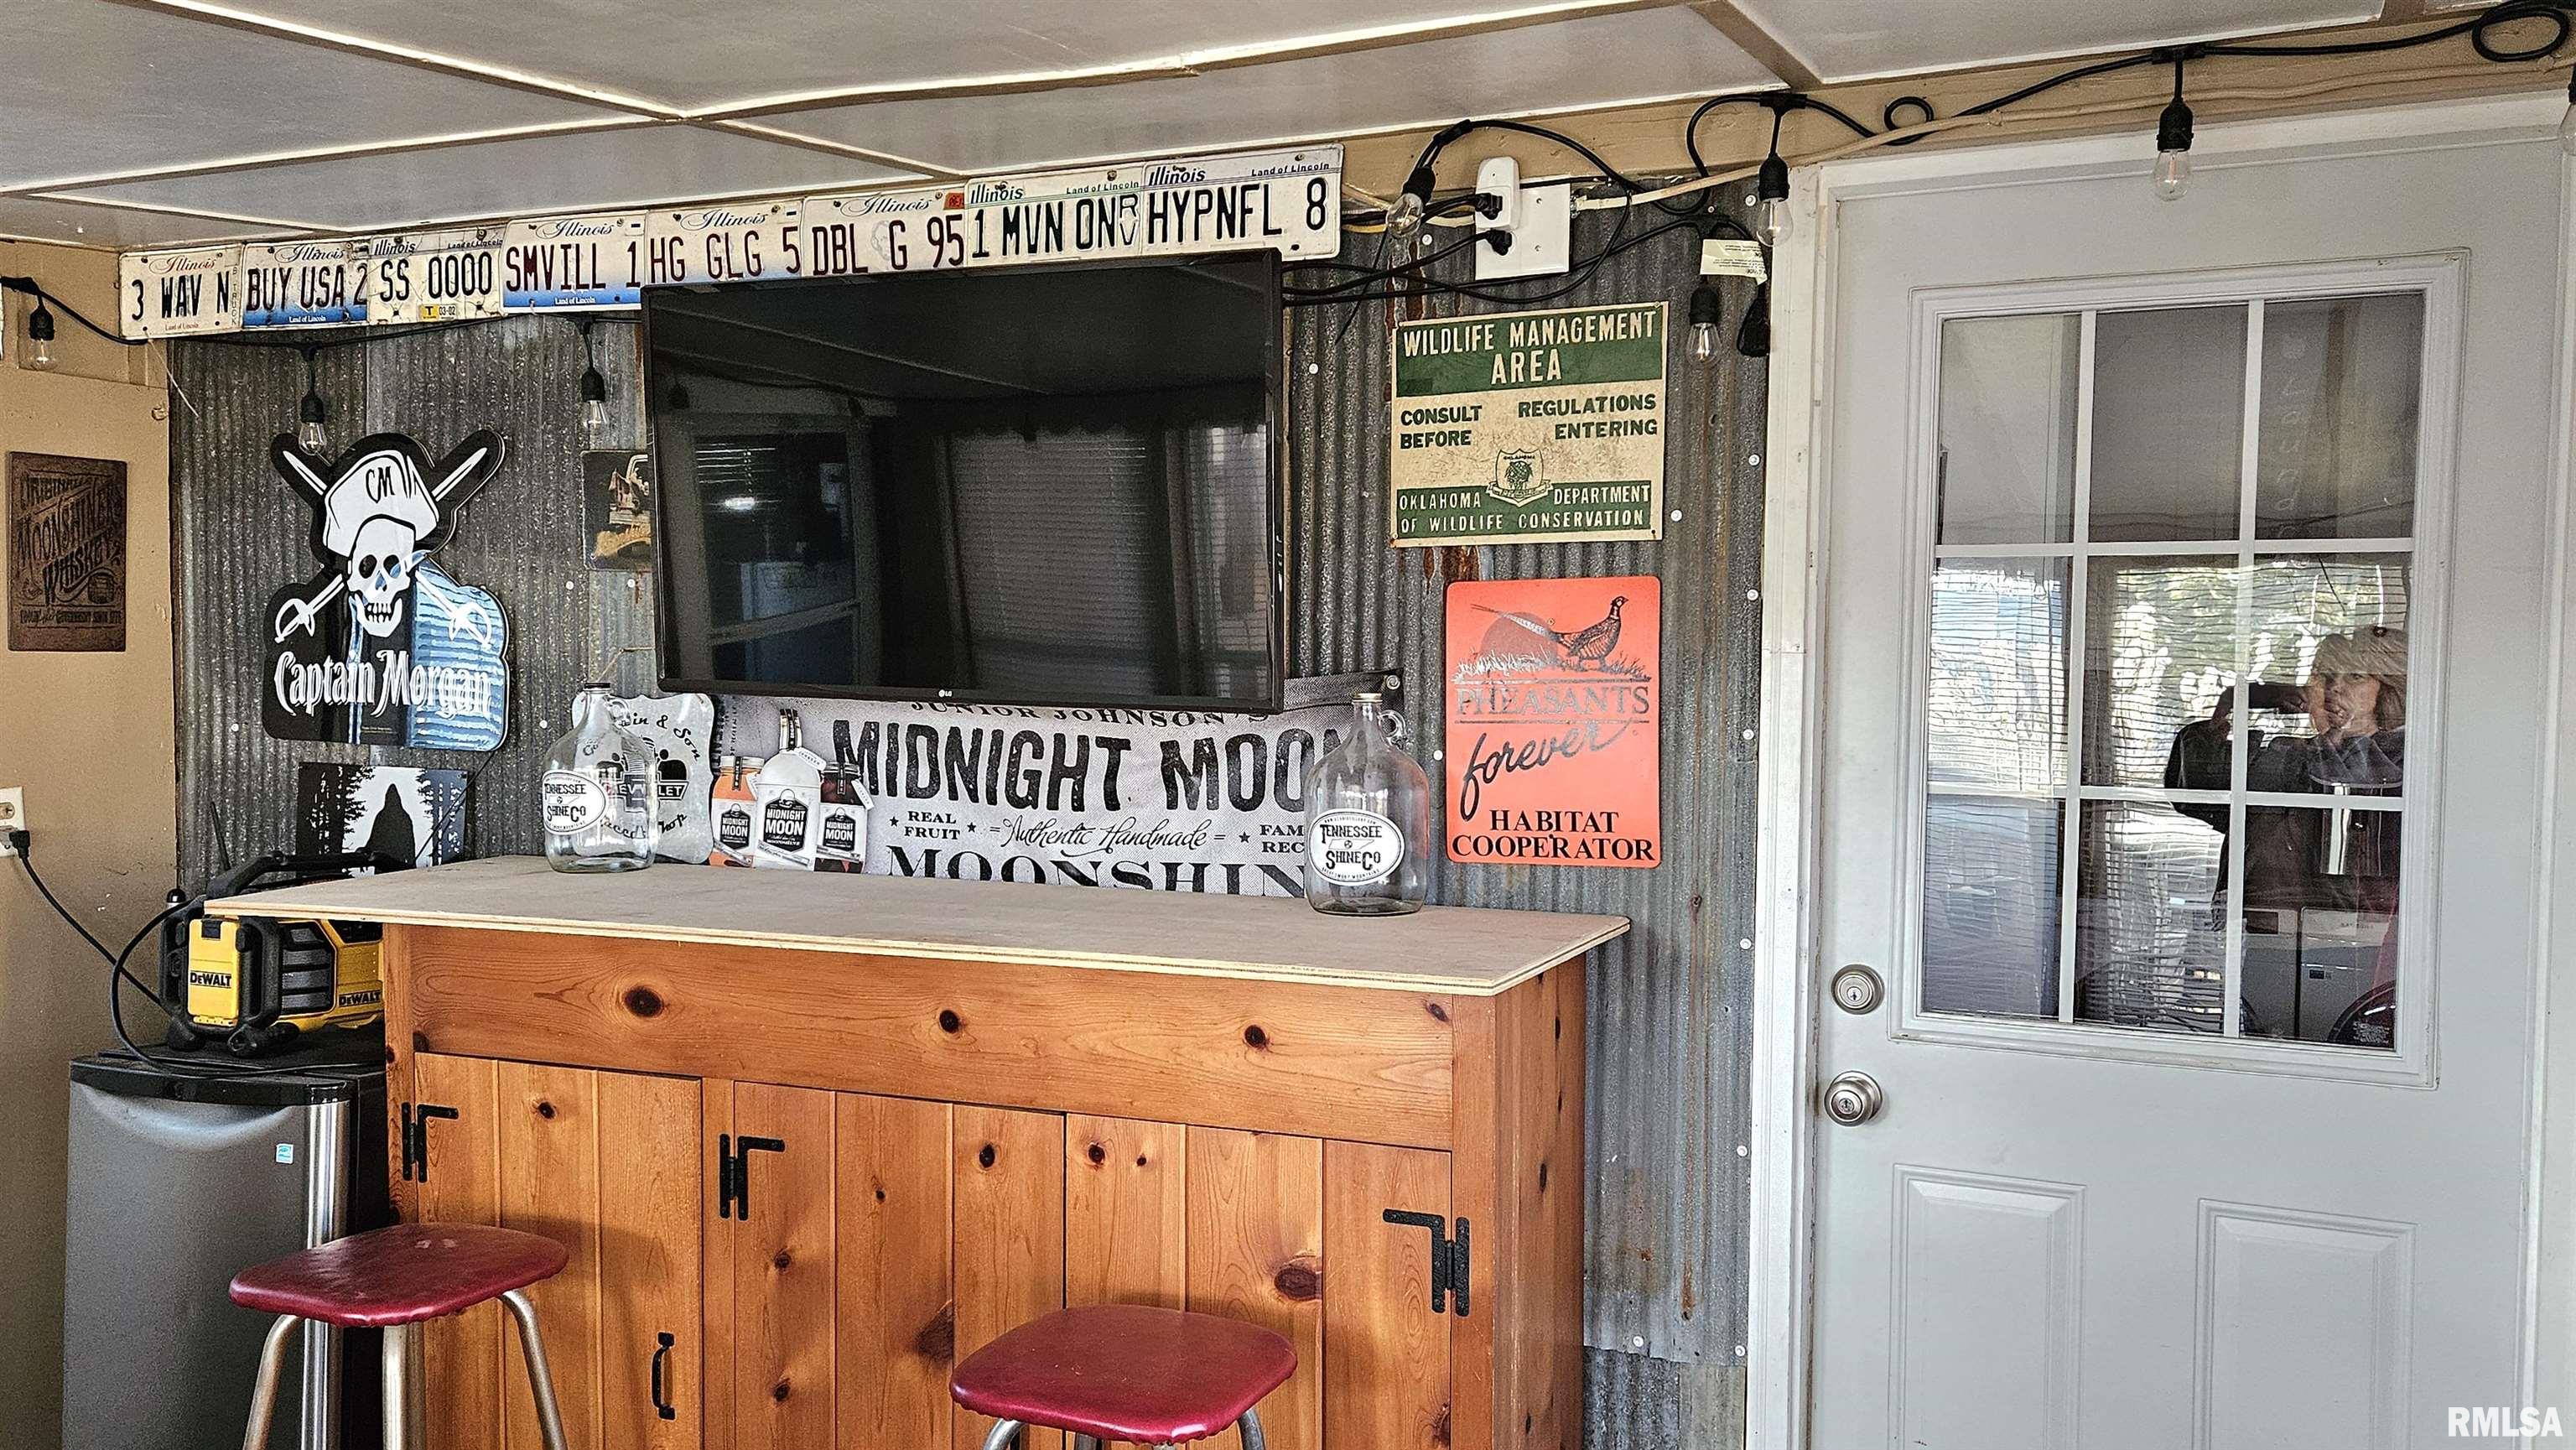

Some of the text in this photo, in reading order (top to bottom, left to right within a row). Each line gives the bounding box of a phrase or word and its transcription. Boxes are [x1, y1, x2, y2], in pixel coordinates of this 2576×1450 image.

[1148, 166, 1206, 186] Illinois
[1252, 168, 1275, 177] Land
[1291, 163, 1329, 172] Lincoln
[970, 182, 1024, 204] Illinois
[1067, 181, 1140, 195] Land of Lincoln
[840, 195, 932, 217] Illinois
[1148, 177, 1327, 245] HYPNFL 8
[536, 220, 614, 239] Illinois
[680, 209, 768, 231] Illinois
[973, 209, 990, 258] 1
[1003, 200, 1064, 256] MVN
[274, 244, 344, 264] Illinois
[374, 239, 417, 257] Illinois
[650, 226, 801, 284] HG GLG 5
[813, 214, 964, 277] DBL G 95
[148, 254, 216, 275] Illinois
[380, 251, 493, 303] SS 0000
[506, 241, 641, 292] SMVILL 1
[132, 270, 230, 320] 3 WAV N
[247, 262, 367, 312] BUY USA 2
[424, 305, 434, 316] T
[1403, 310, 1657, 357] WILDLIFE MANAGEMENT
[1491, 349, 1562, 385] AREA
[1400, 393, 1656, 426] CONSULT REGULATIONS
[1400, 418, 1658, 450] BEFORE ENTERING
[366, 466, 396, 503] CM
[1400, 491, 1481, 511] OKLAHOMA
[1554, 484, 1650, 505] DEPARTMENT
[1401, 508, 1644, 533] OF WILDLIFE CONSERVATION
[274, 650, 491, 719] Captain Morgan
[1456, 685, 1649, 715] PHEASANTS
[657, 714, 668, 730] &
[673, 727, 701, 761] Son
[833, 720, 1131, 812] MIDNIGHT
[1160, 727, 1342, 813] MOO
[1461, 718, 1633, 823] forever
[722, 817, 749, 827] MIDNIGHT
[766, 808, 806, 821] MIDNIGHT
[766, 819, 804, 835] MOON
[826, 820, 854, 830] MIDNIGHT
[908, 810, 957, 824] REAL
[1489, 809, 1619, 833] HABITAT
[721, 825, 748, 837] MOON
[825, 829, 854, 841] MOON
[904, 825, 961, 840] FRUIT
[1000, 815, 1212, 852] Authentic Handmade
[1320, 824, 1382, 844] TENNESSEE
[1452, 834, 1655, 860] COOPERATOR
